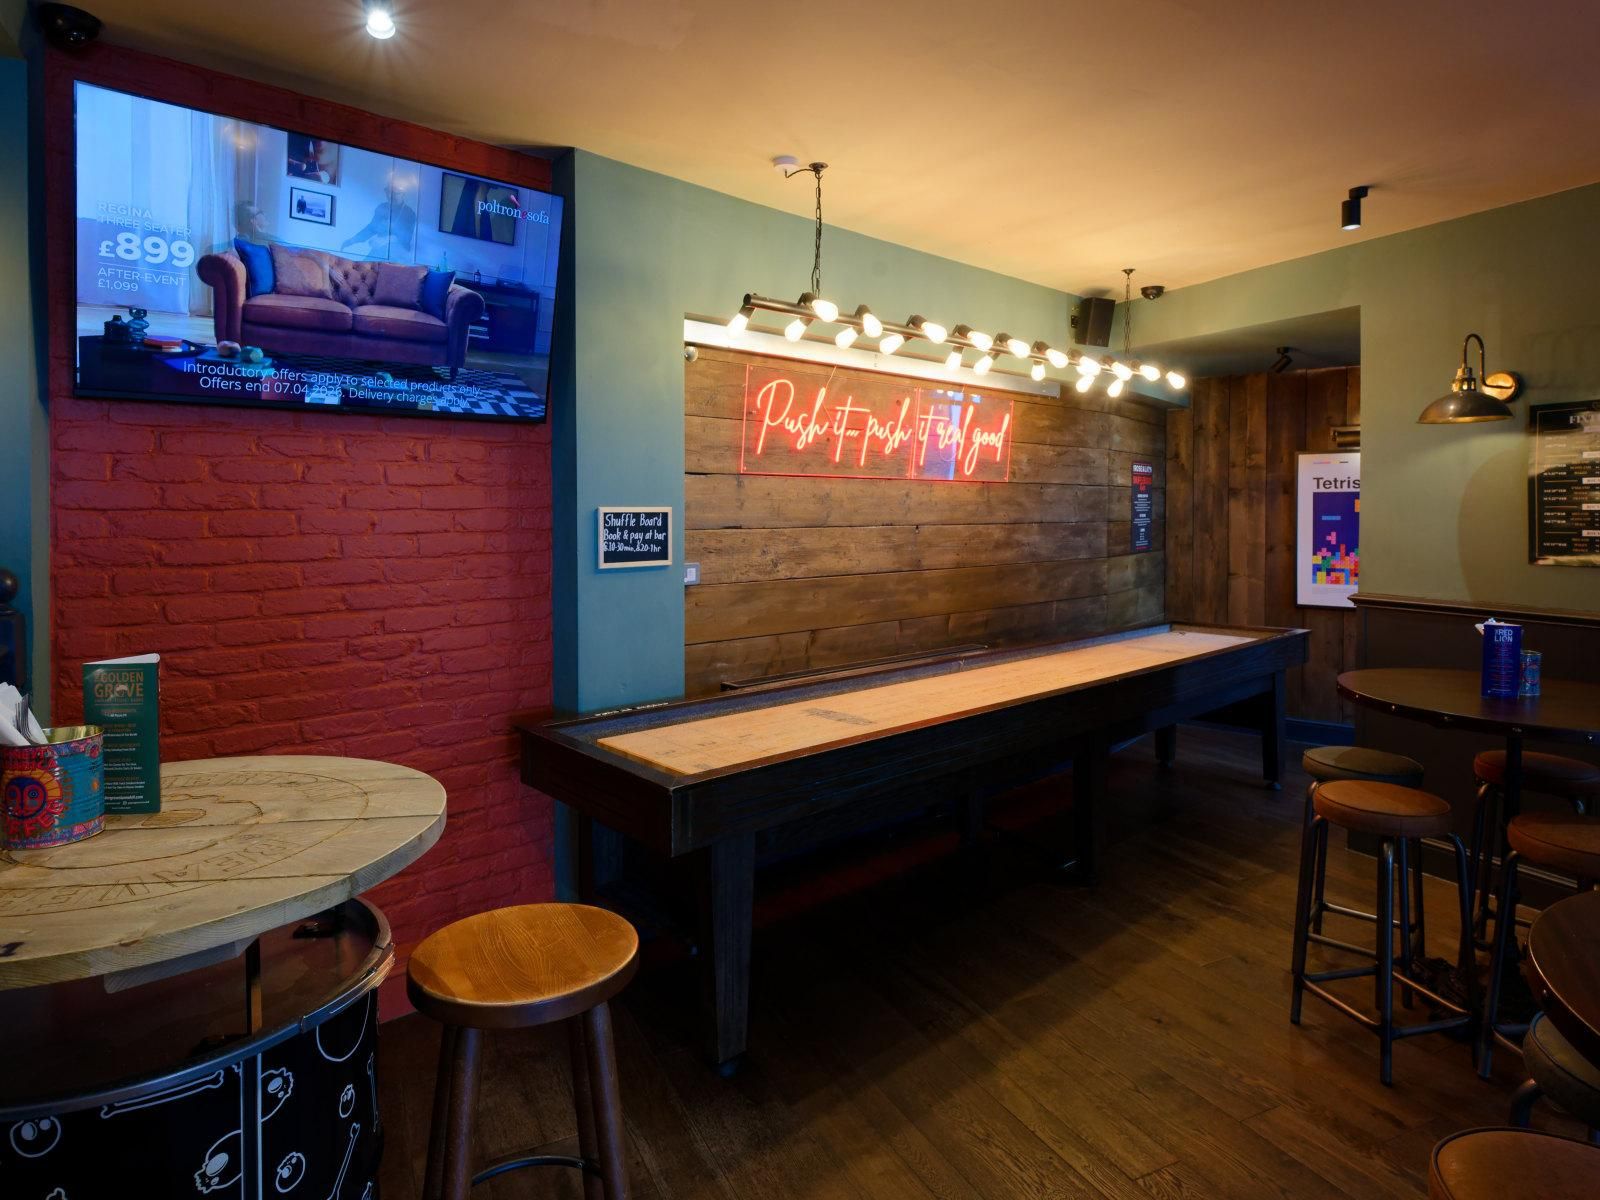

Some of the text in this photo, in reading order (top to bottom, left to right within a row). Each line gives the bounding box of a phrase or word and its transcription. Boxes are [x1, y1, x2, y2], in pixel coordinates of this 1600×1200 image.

[98, 201, 153, 219] REGINA
[477, 199, 550, 225] poltronesofa
[98, 214, 192, 237] THREE SEATER
[98, 232, 195, 268] £899
[98, 278, 139, 292] £1,099
[183, 361, 269, 381] Introductory
[271, 368, 307, 382] offers
[310, 373, 343, 386] apply
[345, 376, 358, 386] to
[361, 376, 408, 389] selected
[410, 380, 457, 393] products
[200, 376, 242, 390] Offers
[245, 381, 270, 392] end
[349, 387, 394, 403] Delivery
[396, 391, 438, 406] charges
[757, 379, 829, 455] Push
[860, 397, 912, 466] push
[918, 404, 950, 467] it
[936, 405, 974, 460] real
[964, 413, 1010, 475] good
[1313, 476, 1361, 490] Tetris
[605, 513, 662, 527] Shuffle Board
[603, 527, 667, 545] Book & pay at bar
[1498, 628, 1513, 636] RED
[100, 671, 144, 683] GOLDEN
[94, 683, 144, 698] GROVE
